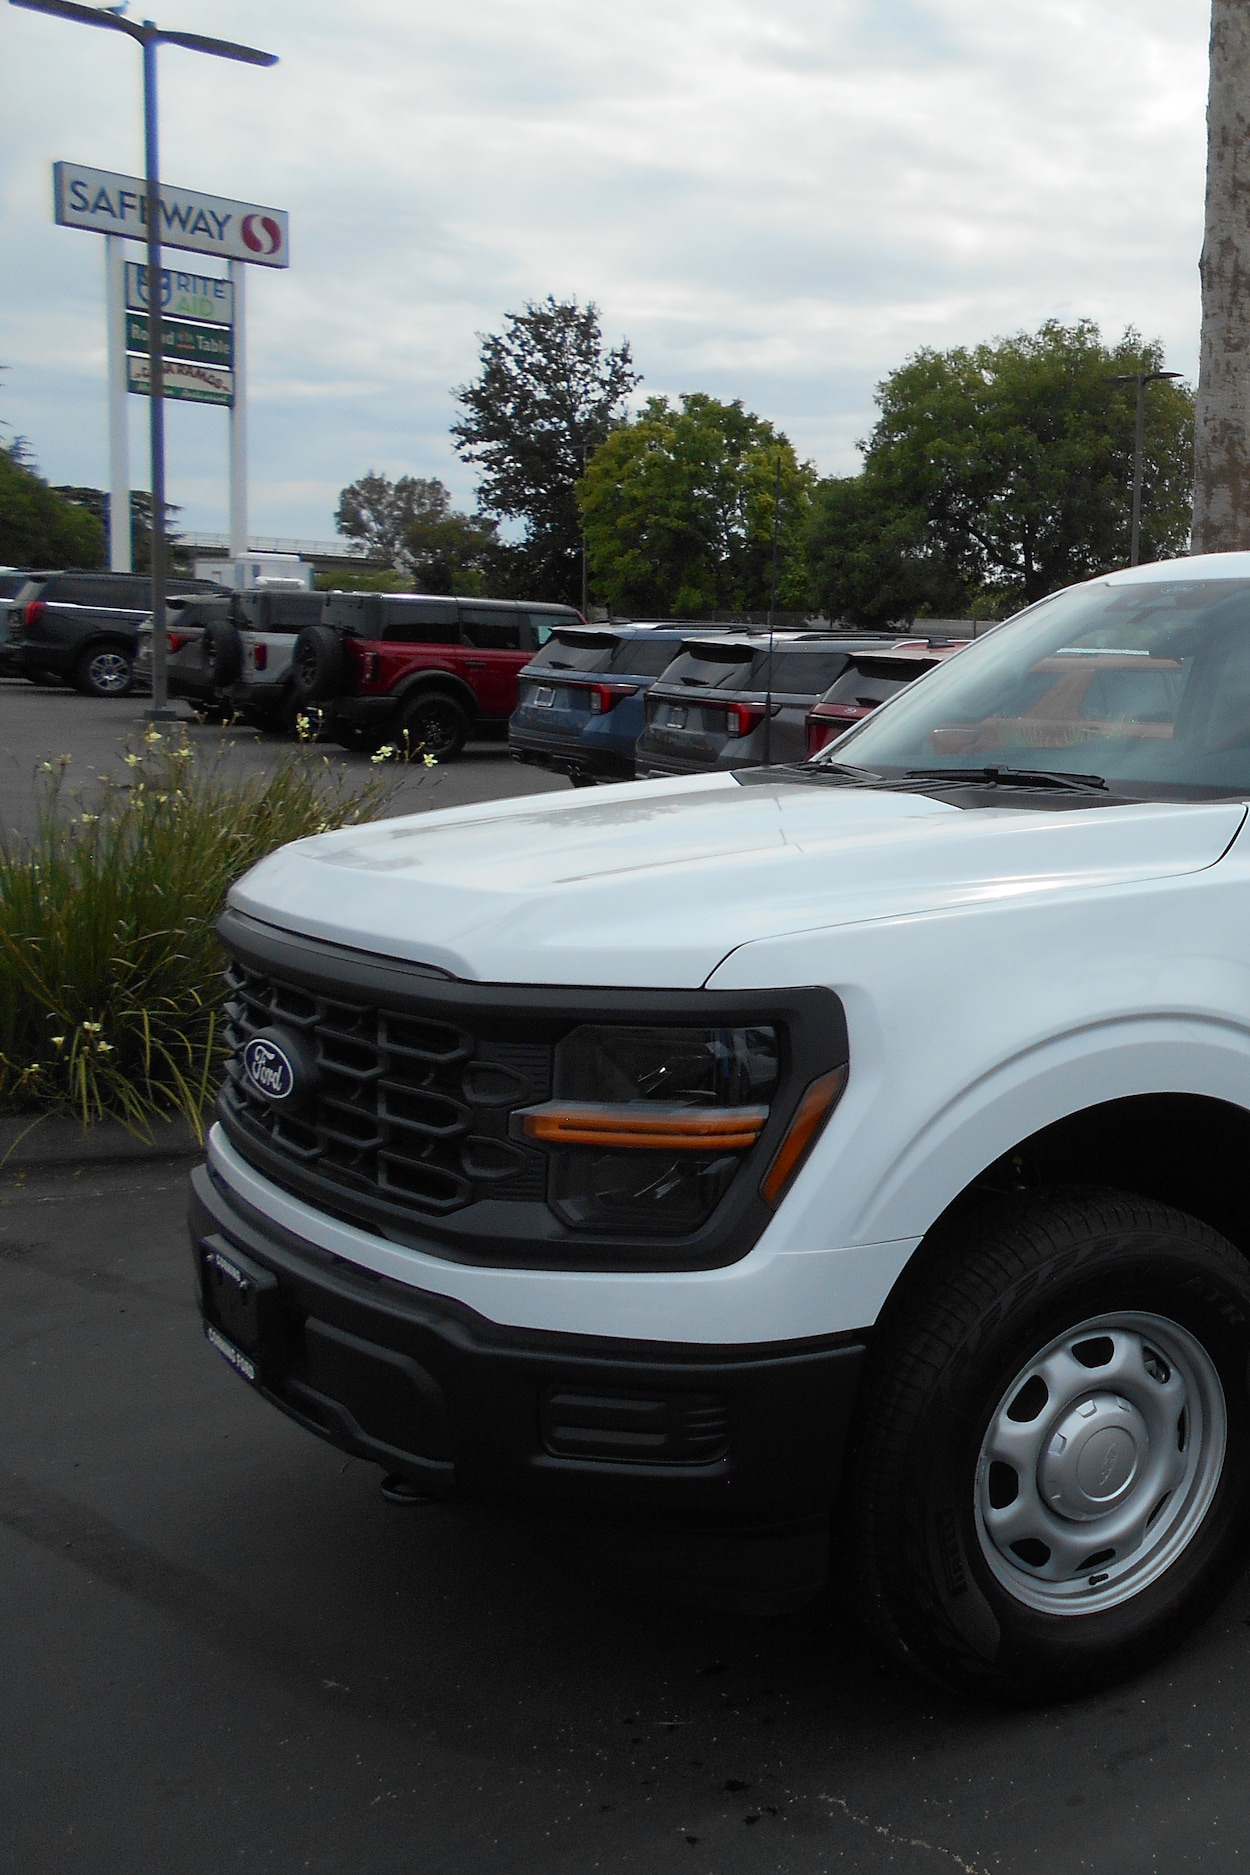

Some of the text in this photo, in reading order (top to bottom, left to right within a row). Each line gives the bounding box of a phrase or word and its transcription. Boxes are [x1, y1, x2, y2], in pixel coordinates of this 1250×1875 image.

[177, 272, 226, 299] RITE
[176, 295, 214, 317] AID
[196, 335, 231, 354] Table
[252, 1045, 283, 1091] Ford
